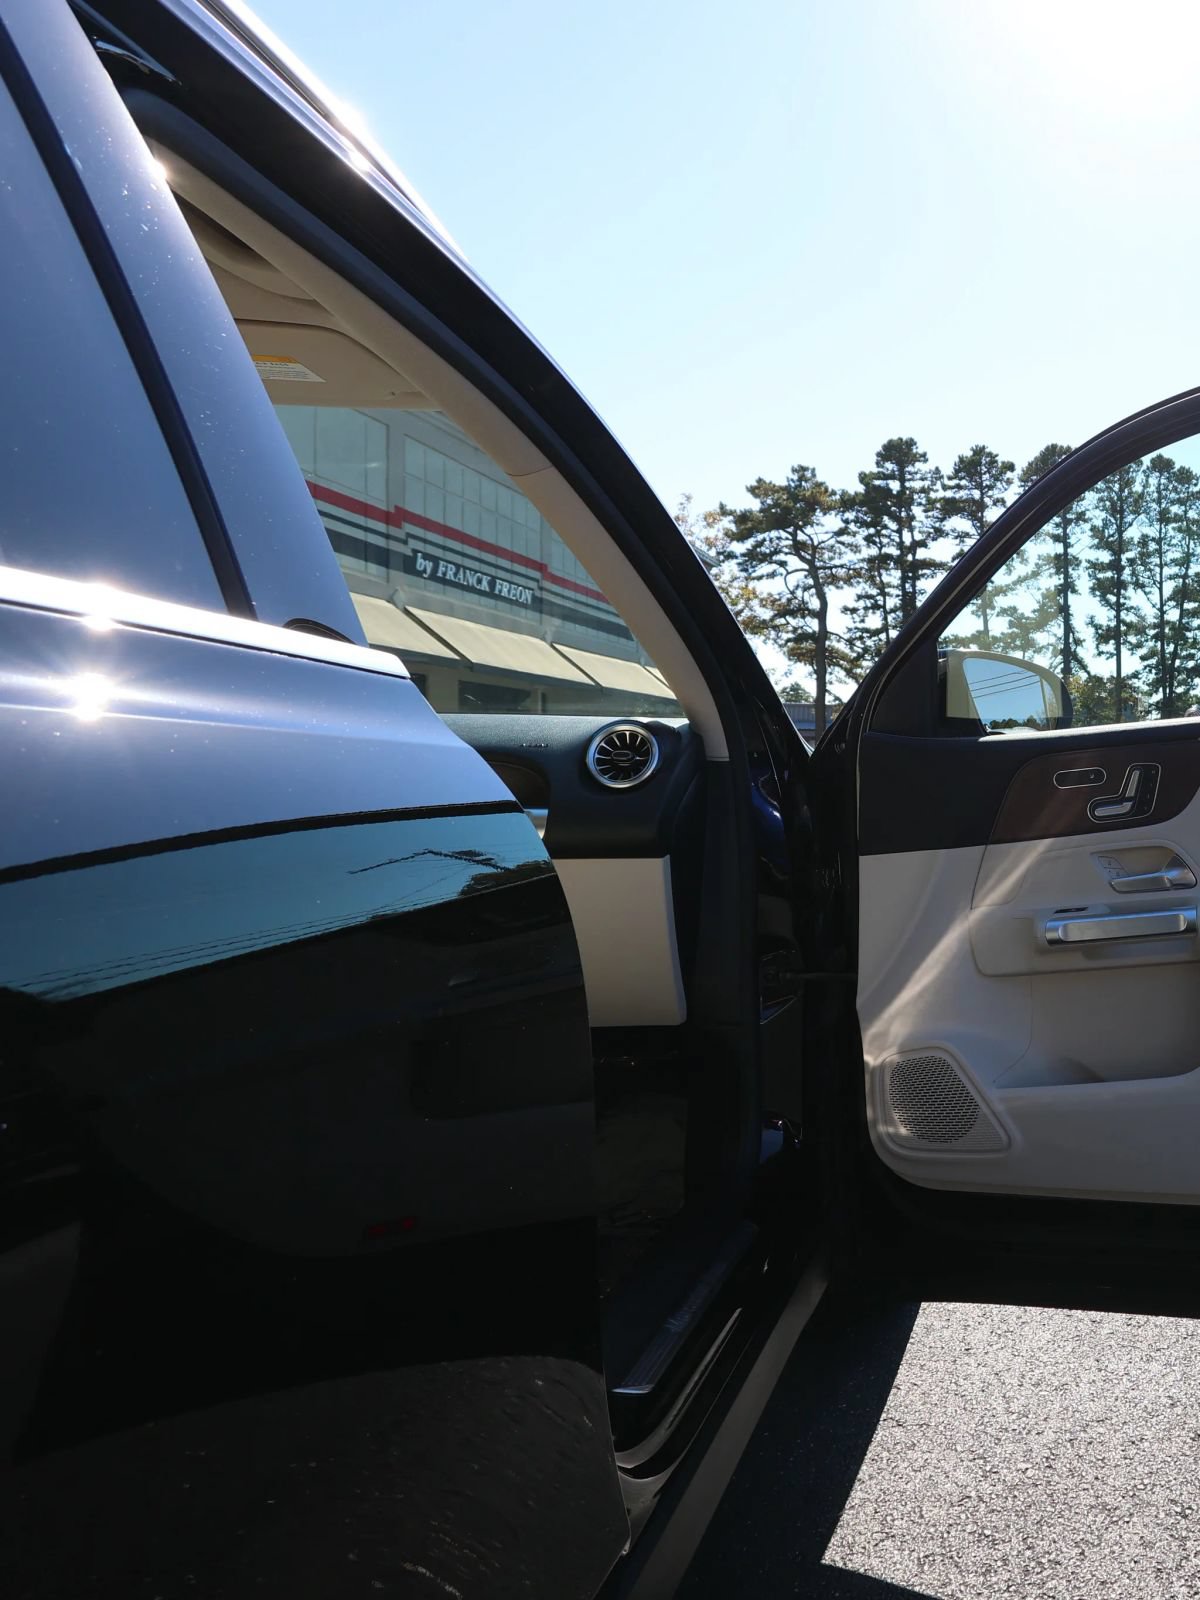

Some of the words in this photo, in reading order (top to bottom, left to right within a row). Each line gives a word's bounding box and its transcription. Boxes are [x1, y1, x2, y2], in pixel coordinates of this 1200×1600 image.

[416, 553, 432, 577] by
[437, 560, 491, 592] FRANCK
[494, 579, 533, 604] FREON
